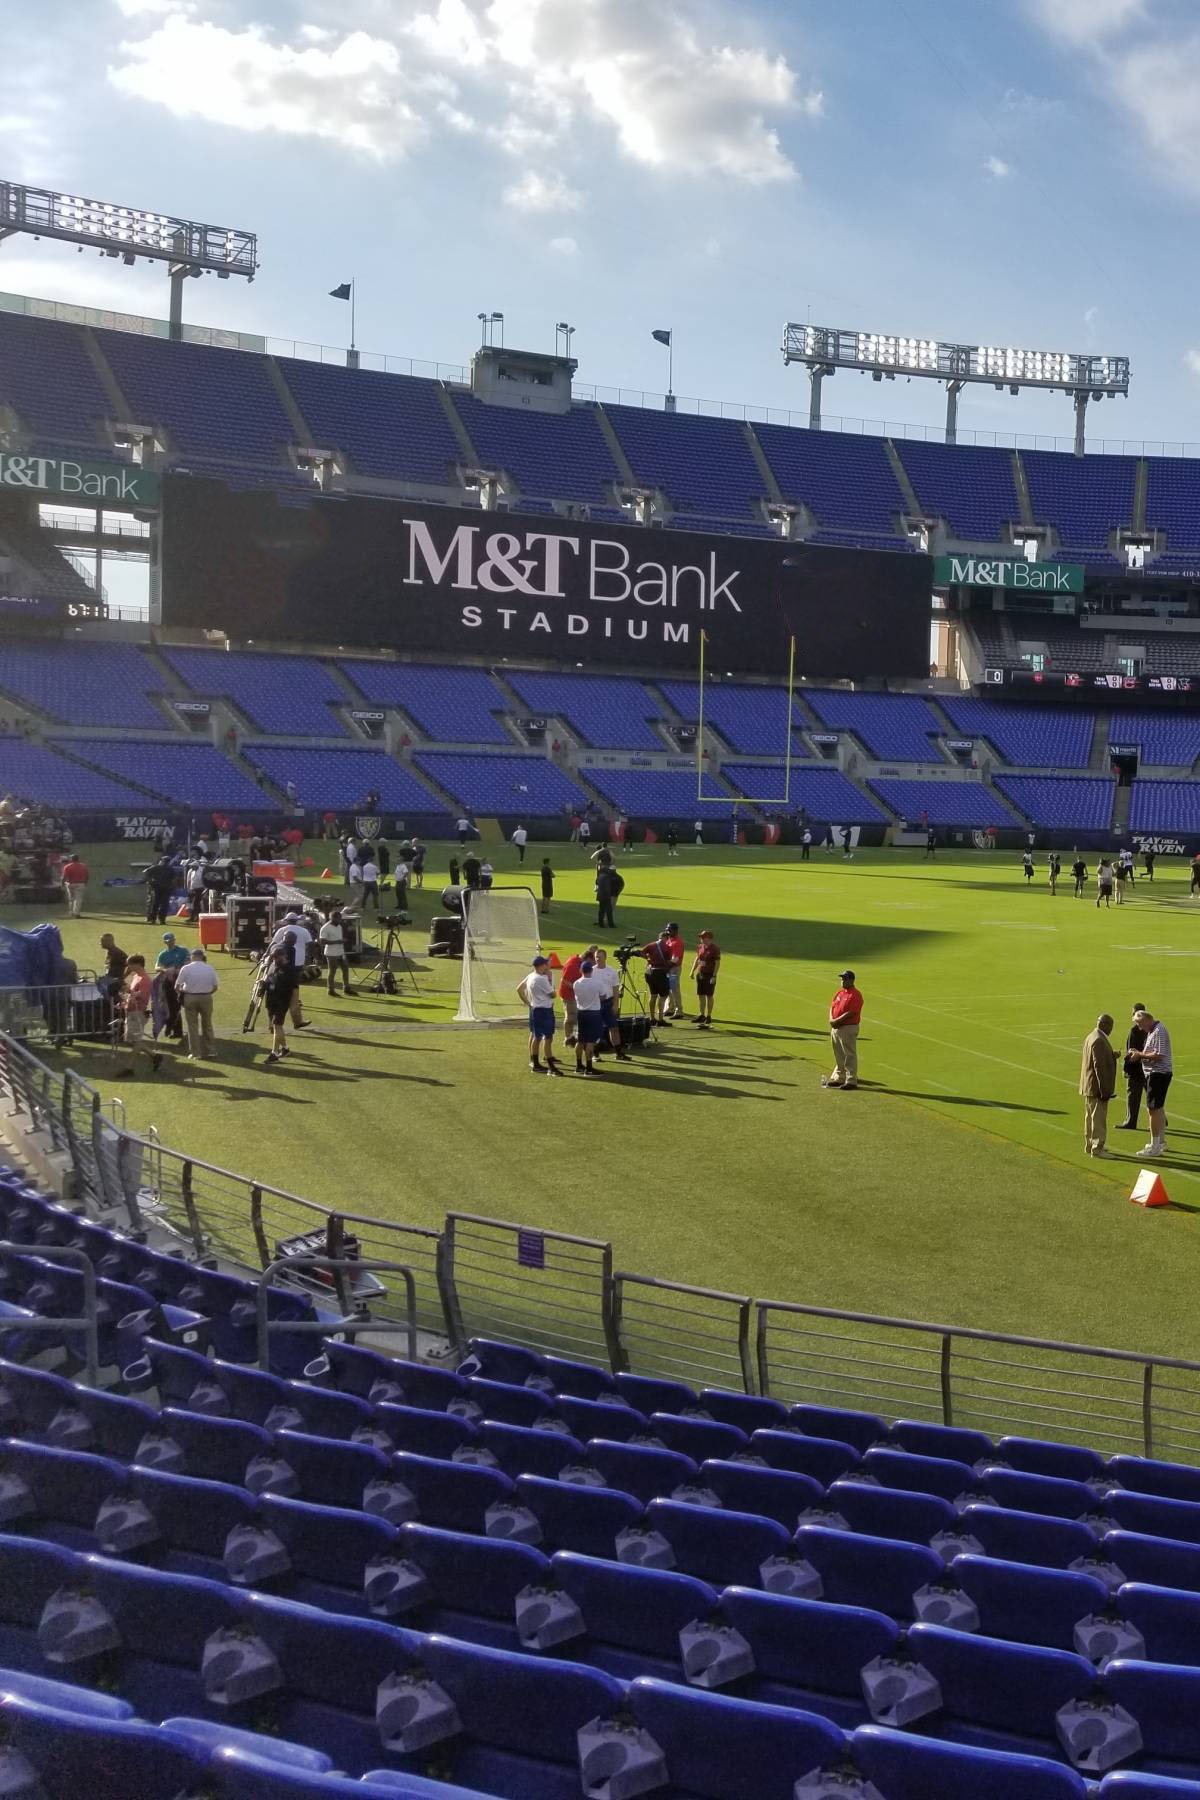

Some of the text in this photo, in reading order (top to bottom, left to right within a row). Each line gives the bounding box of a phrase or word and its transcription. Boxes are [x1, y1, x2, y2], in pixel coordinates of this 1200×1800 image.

[59, 461, 139, 500] Bank
[402, 519, 742, 612] M&T Bank
[949, 558, 1070, 590] M&T Bank
[461, 605, 689, 643] STADIUM
[115, 817, 147, 827] PLAY
[1131, 836, 1161, 844] PLAY
[1139, 843, 1186, 854] RAVEN
